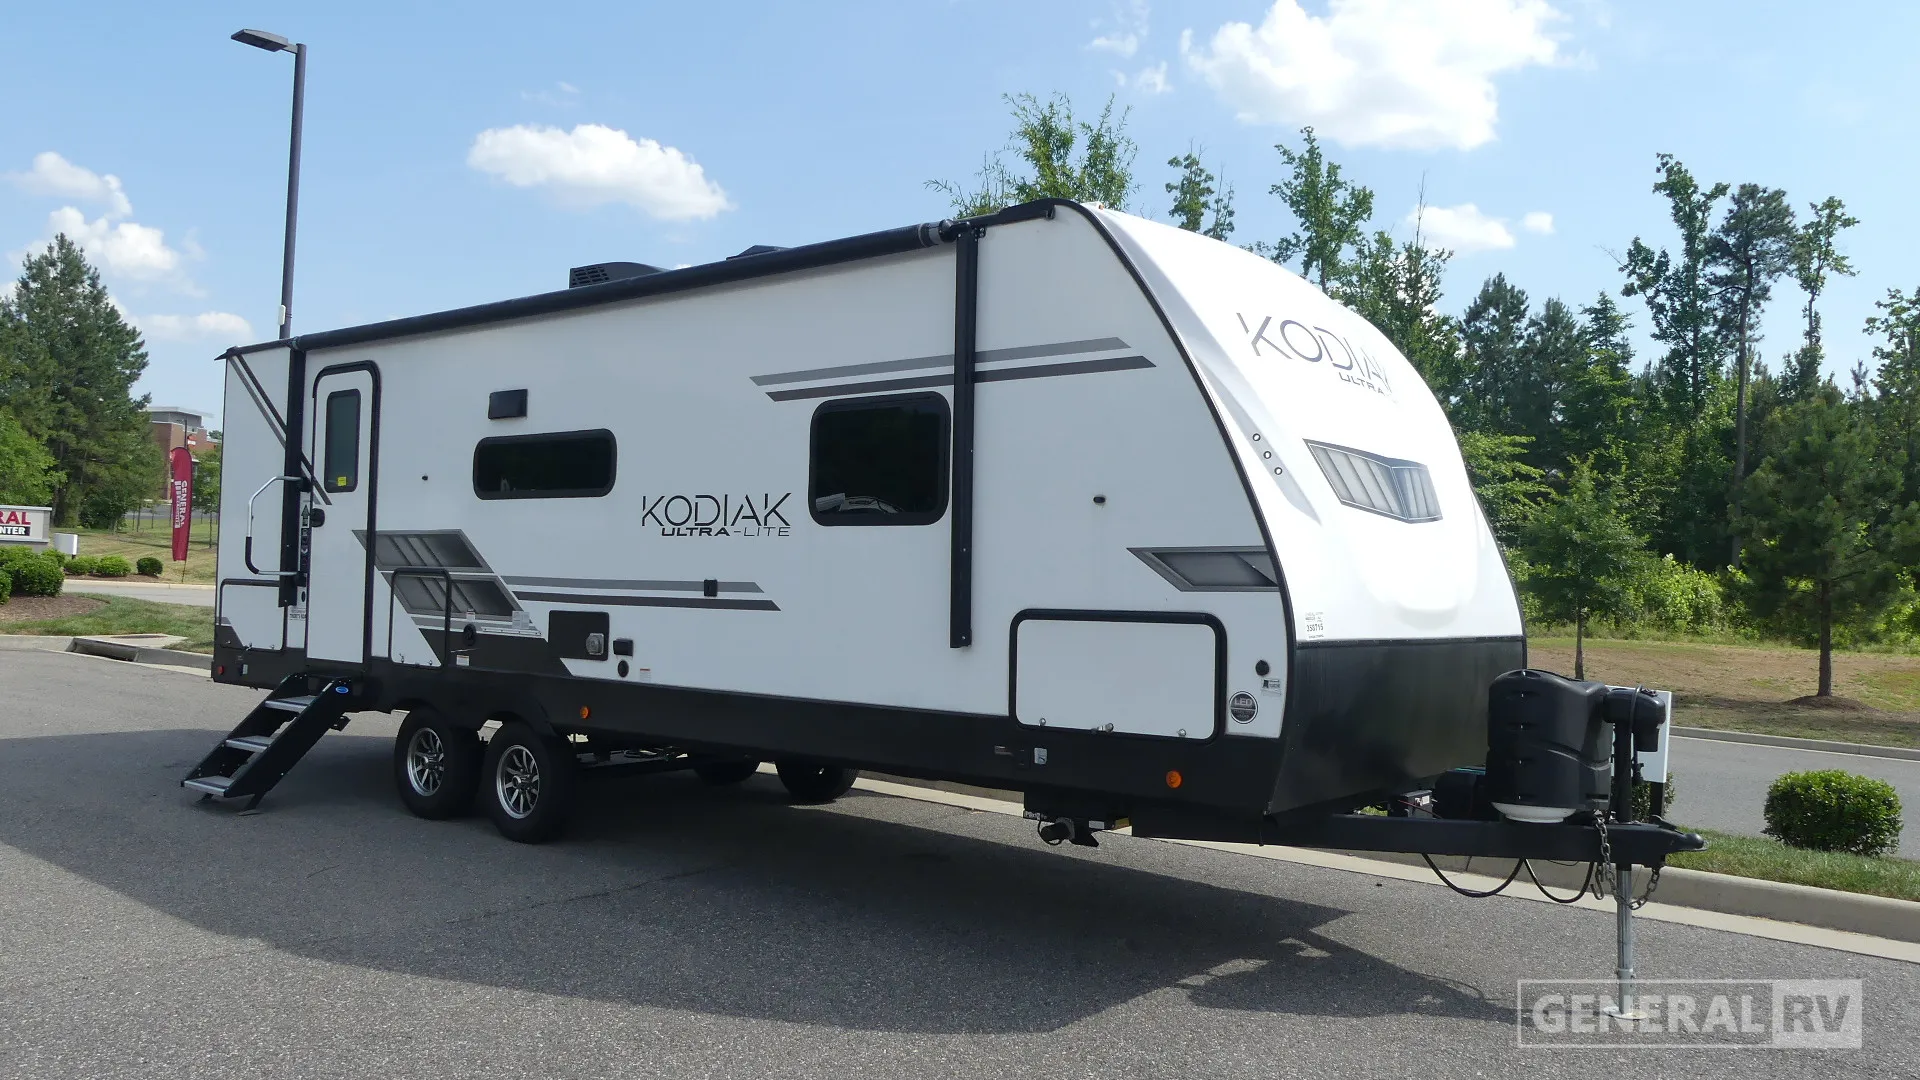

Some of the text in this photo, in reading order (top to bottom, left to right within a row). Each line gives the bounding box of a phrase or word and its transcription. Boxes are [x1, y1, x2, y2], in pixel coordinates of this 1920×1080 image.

[1338, 371, 1386, 397] ULTRA
[179, 480, 188, 528] GENERAL
[641, 492, 792, 527] KODIAK
[661, 526, 792, 537] ULTRA-LITE
[1234, 697, 1253, 706] LED
